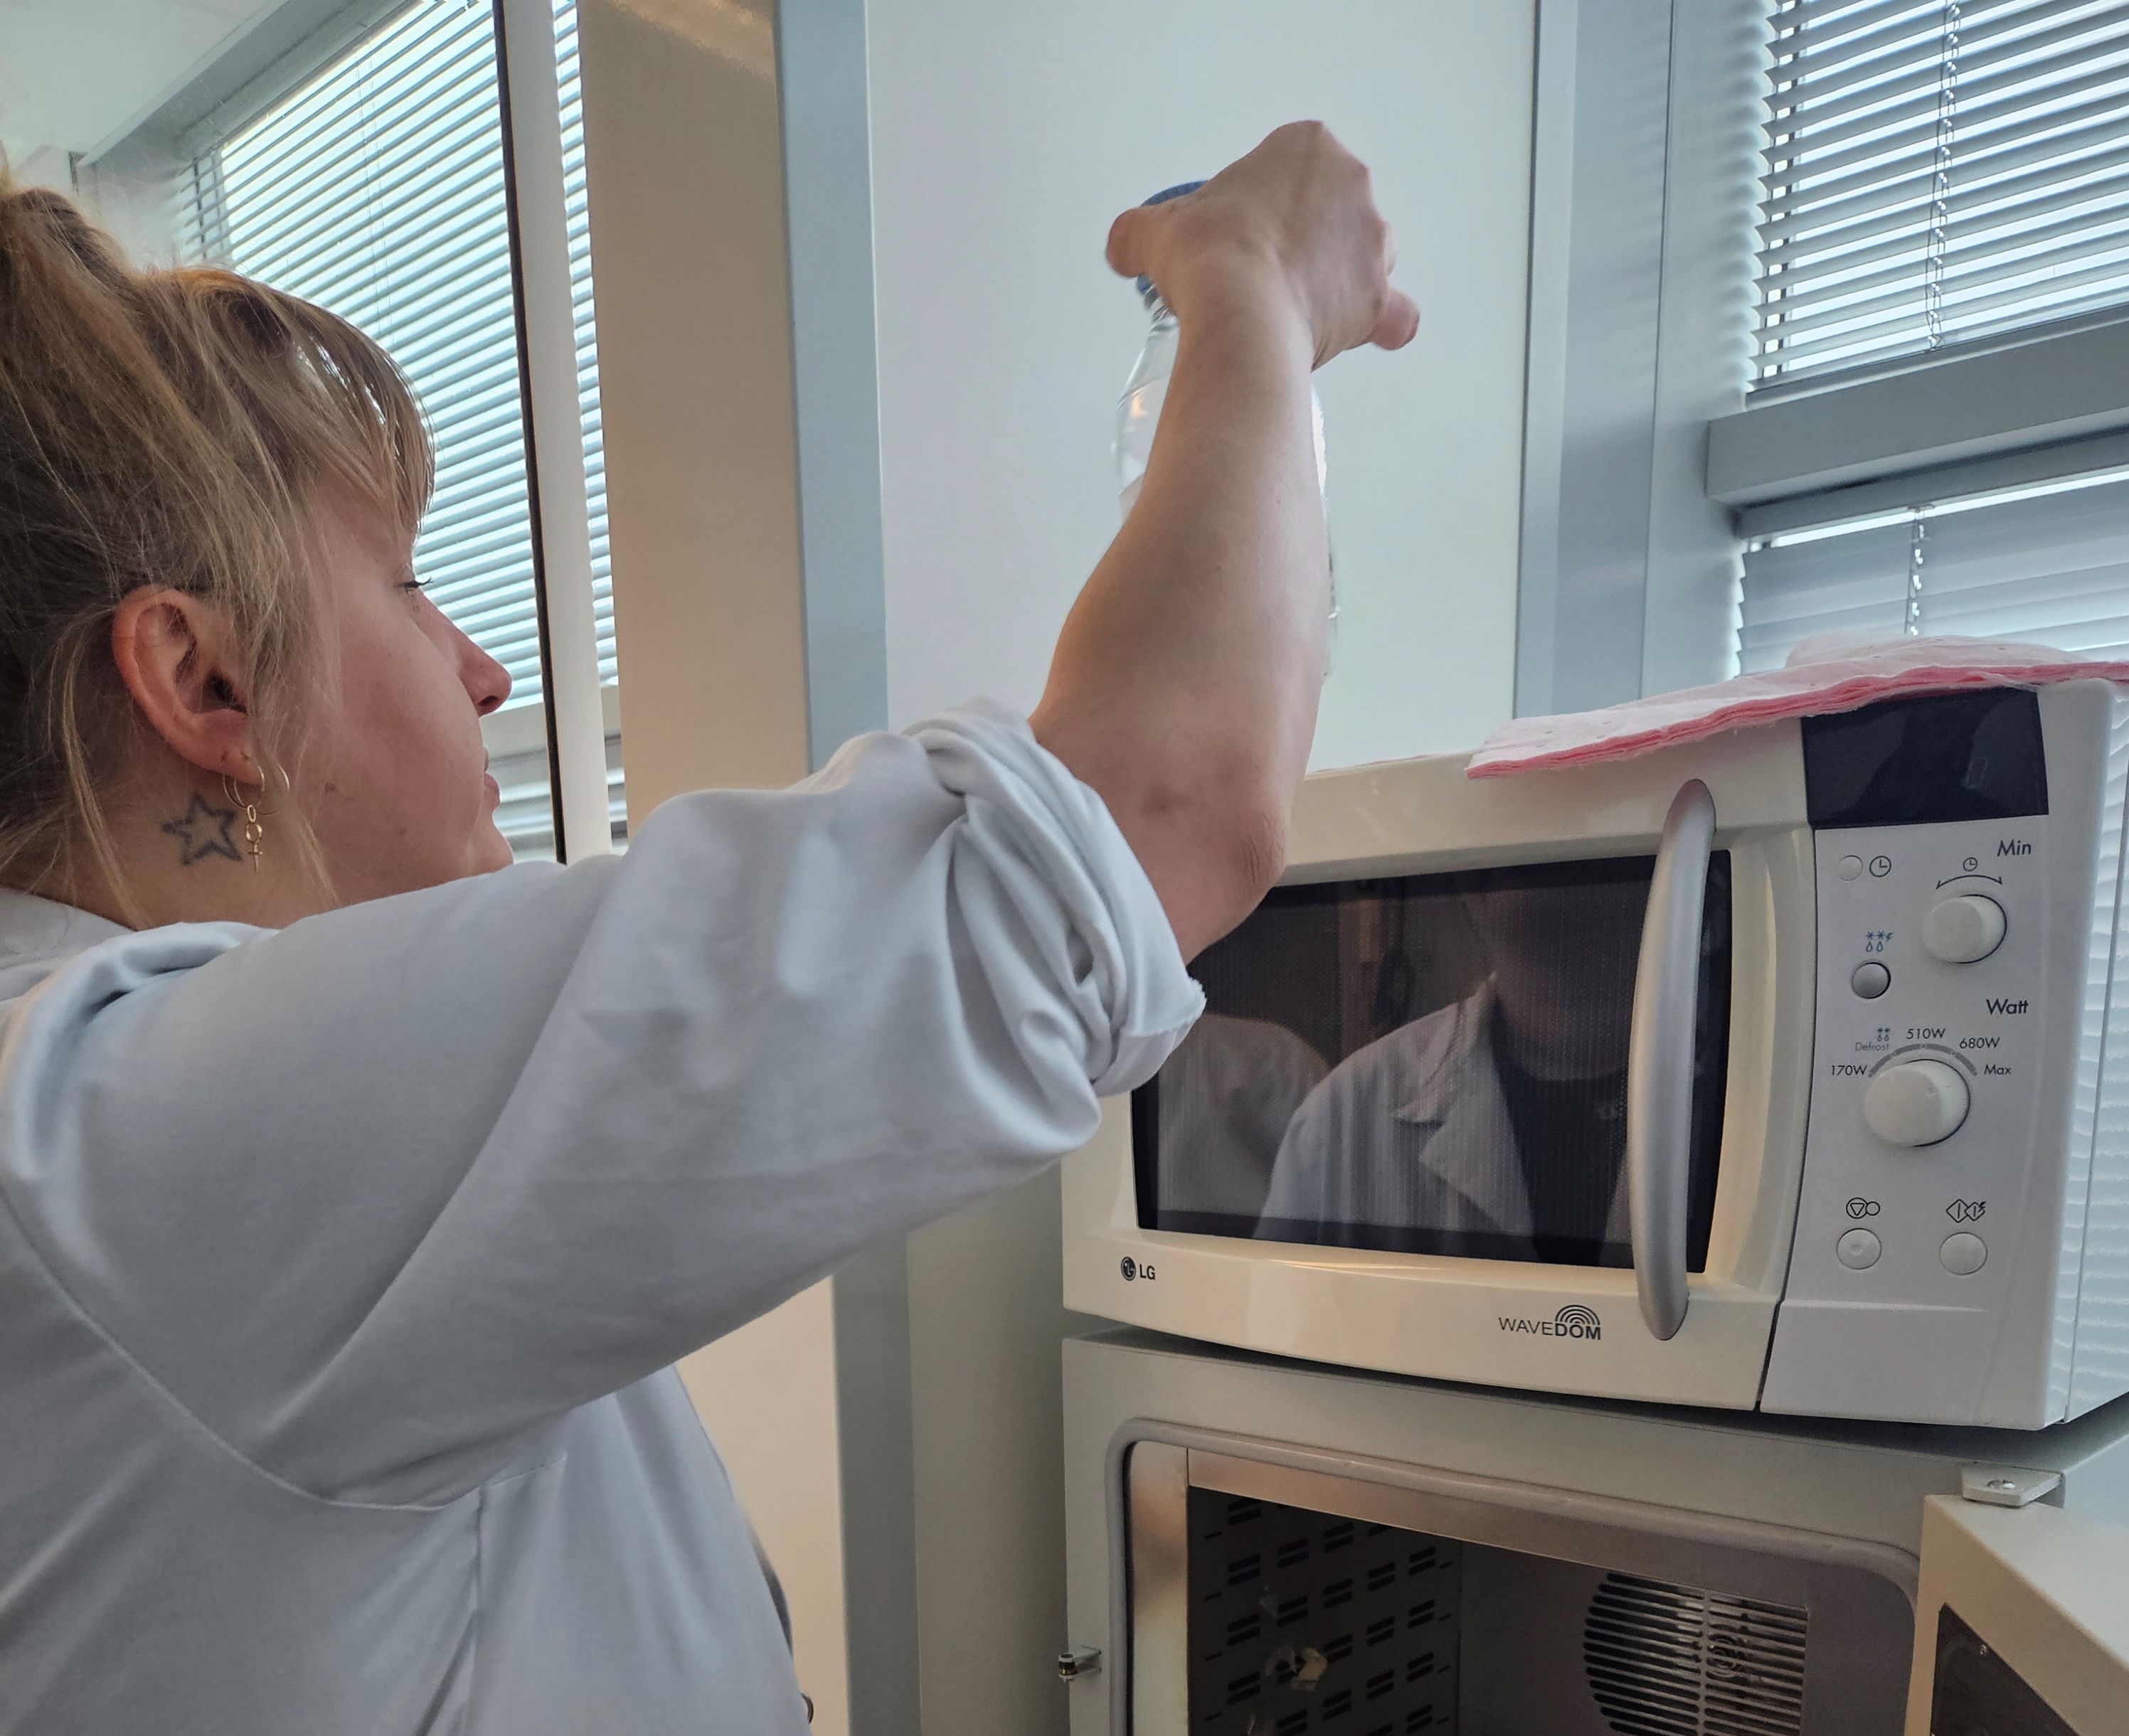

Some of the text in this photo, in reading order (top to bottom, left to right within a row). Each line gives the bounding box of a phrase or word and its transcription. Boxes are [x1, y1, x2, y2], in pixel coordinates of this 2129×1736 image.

[1997, 838, 2032, 857] Min
[1985, 998, 2029, 1015] Watt
[1906, 1028, 1946, 1040] 510W
[1854, 1042, 1890, 1052] Defrost
[1959, 1037, 2000, 1049] 680W
[1832, 1064, 1867, 1076] 170W
[1983, 1064, 2012, 1076] Max
[1140, 1264, 1156, 1281] LG
[1498, 1317, 1601, 1341] WAVEDOM
